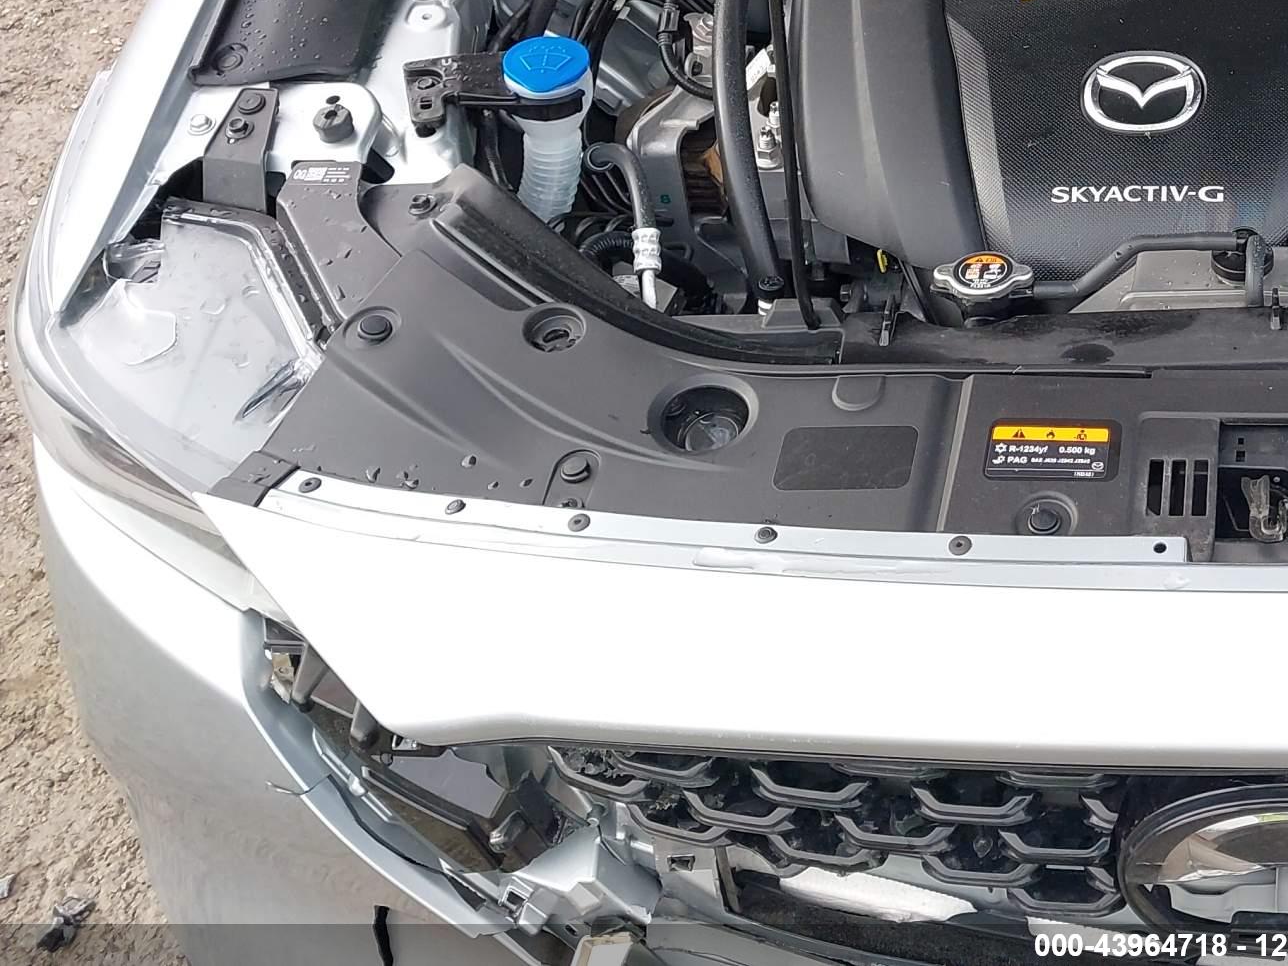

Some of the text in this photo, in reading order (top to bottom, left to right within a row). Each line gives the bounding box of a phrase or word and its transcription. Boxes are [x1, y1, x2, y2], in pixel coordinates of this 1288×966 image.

[1050, 185, 1225, 203] SKYACTIV-G
[1008, 445, 1096, 457] R-1234yf 0.500 kg
[1006, 455, 1028, 464] PAG
